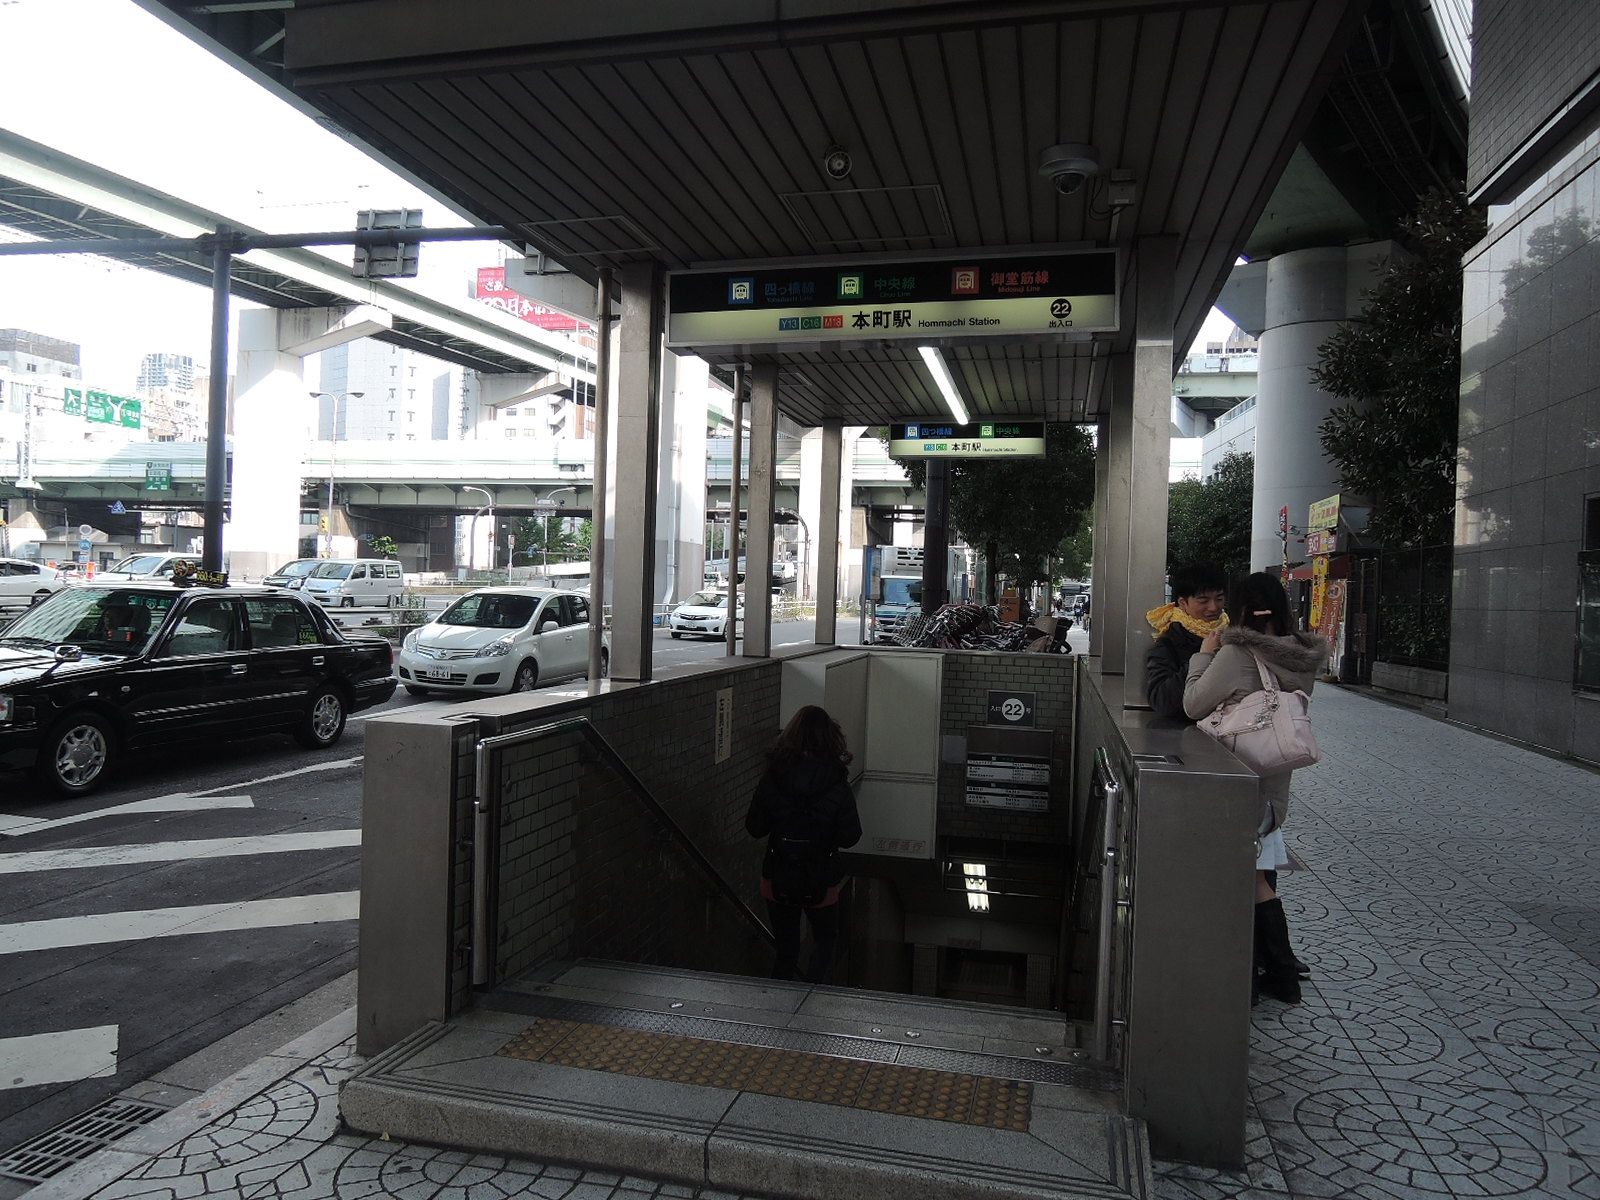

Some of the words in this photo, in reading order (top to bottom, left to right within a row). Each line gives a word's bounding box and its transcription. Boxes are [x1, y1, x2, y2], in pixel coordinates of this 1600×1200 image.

[874, 276, 917, 290] 中央線
[990, 270, 1050, 286] 御堂筋線
[1052, 303, 1070, 314] 22
[781, 318, 797, 329] Y13
[802, 317, 820, 328] C16
[824, 316, 842, 327] M18
[852, 309, 912, 330] 本町駅
[918, 318, 966, 328] Hommachi
[968, 317, 1001, 326] Station
[1048, 320, 1073, 328] 出入口
[951, 442, 982, 452] 本町駅
[1005, 703, 1022, 716] 22
